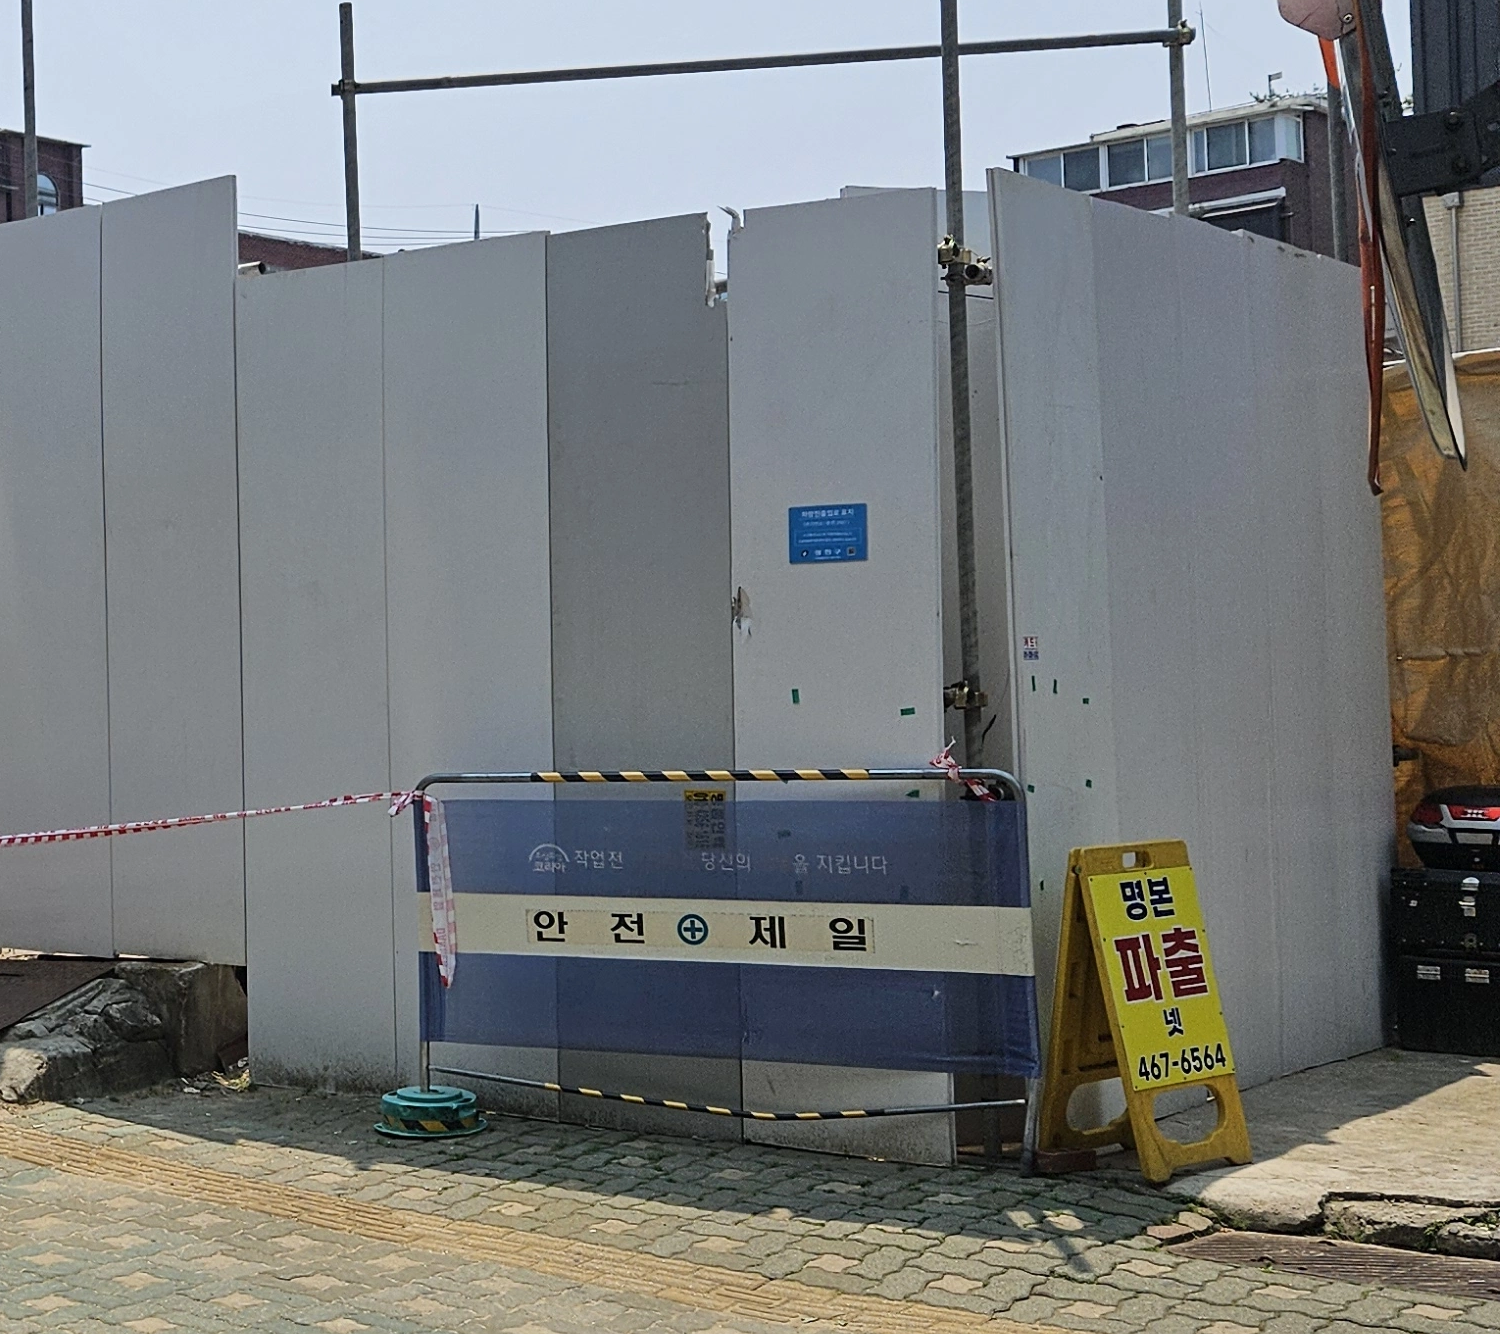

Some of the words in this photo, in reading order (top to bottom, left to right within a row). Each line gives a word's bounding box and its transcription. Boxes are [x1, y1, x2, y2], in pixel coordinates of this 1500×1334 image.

[701, 852, 751, 873] 당신의
[816, 854, 889, 875] 지킵니다
[1119, 876, 1176, 921] 명본
[1114, 927, 1209, 1002] 파출
[1163, 1007, 1184, 1038] 넷
[1138, 1043, 1226, 1082] 467-6564
